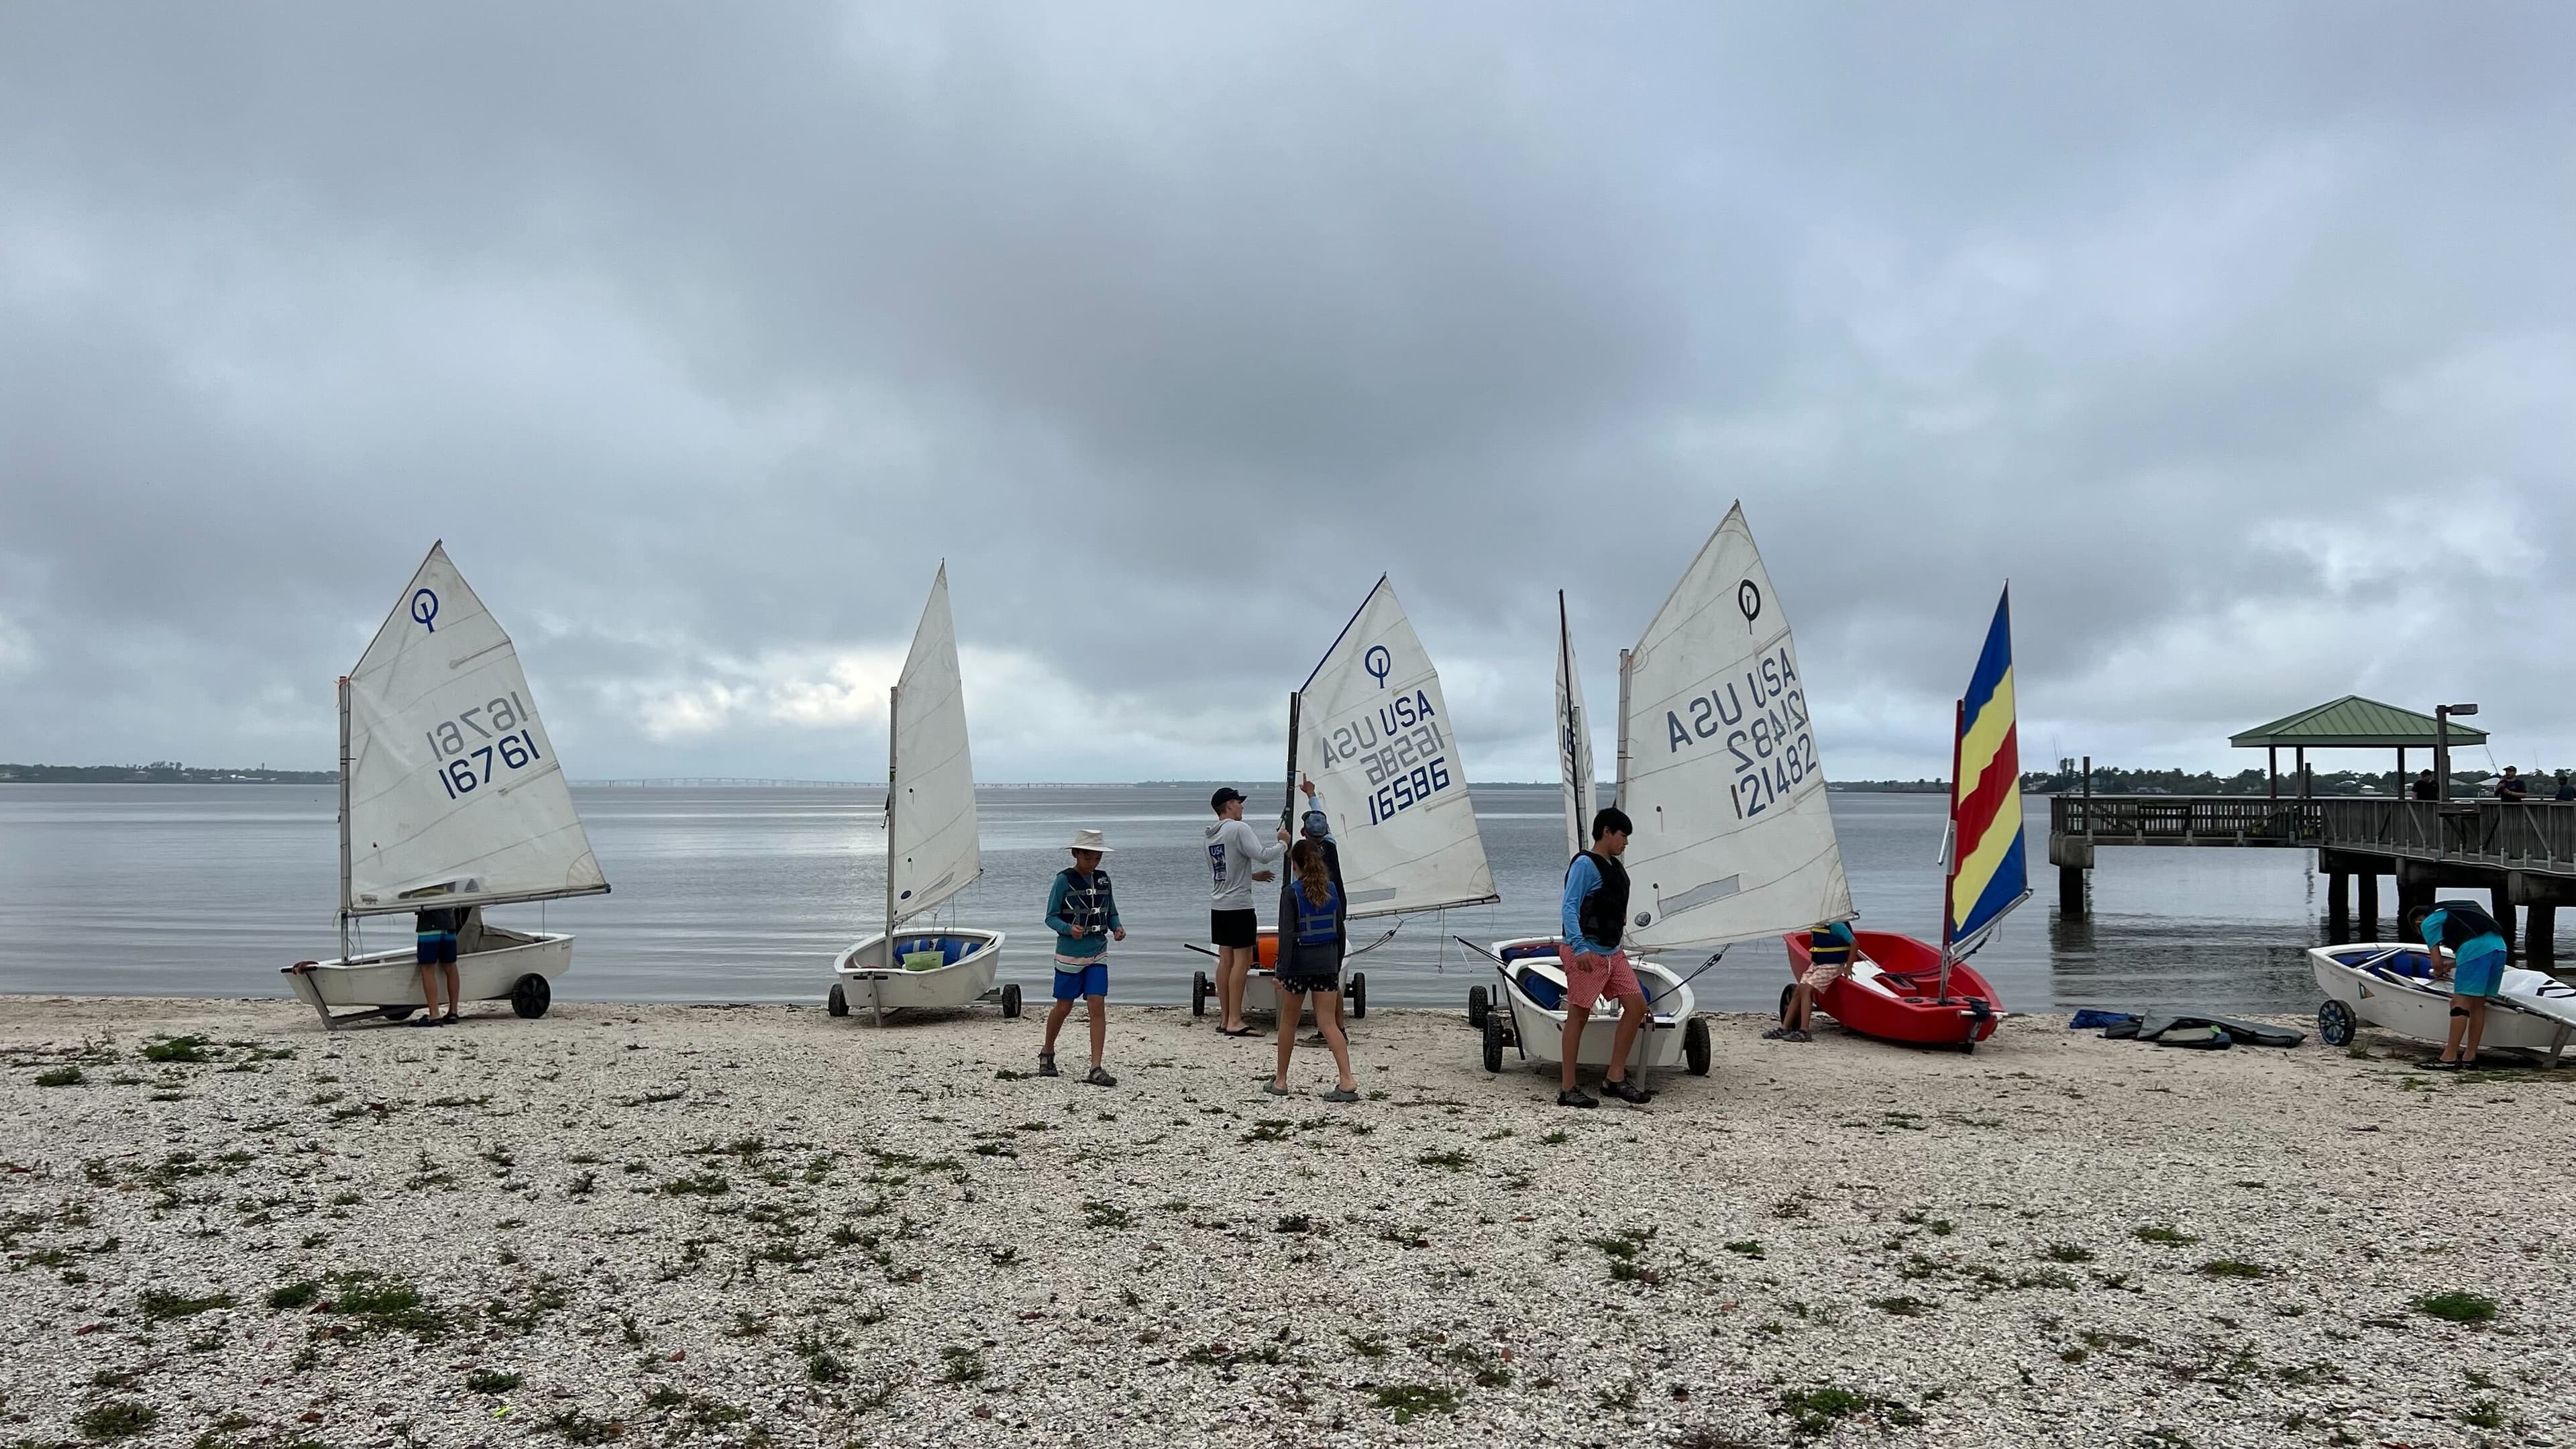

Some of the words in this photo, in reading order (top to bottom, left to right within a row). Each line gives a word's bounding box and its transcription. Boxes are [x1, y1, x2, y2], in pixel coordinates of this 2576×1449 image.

[1748, 647, 1796, 708] USA
[1379, 690, 1435, 736] USA
[438, 729, 541, 800] 16761
[1368, 757, 1450, 826] 16586
[1730, 733, 1817, 820] 121482
